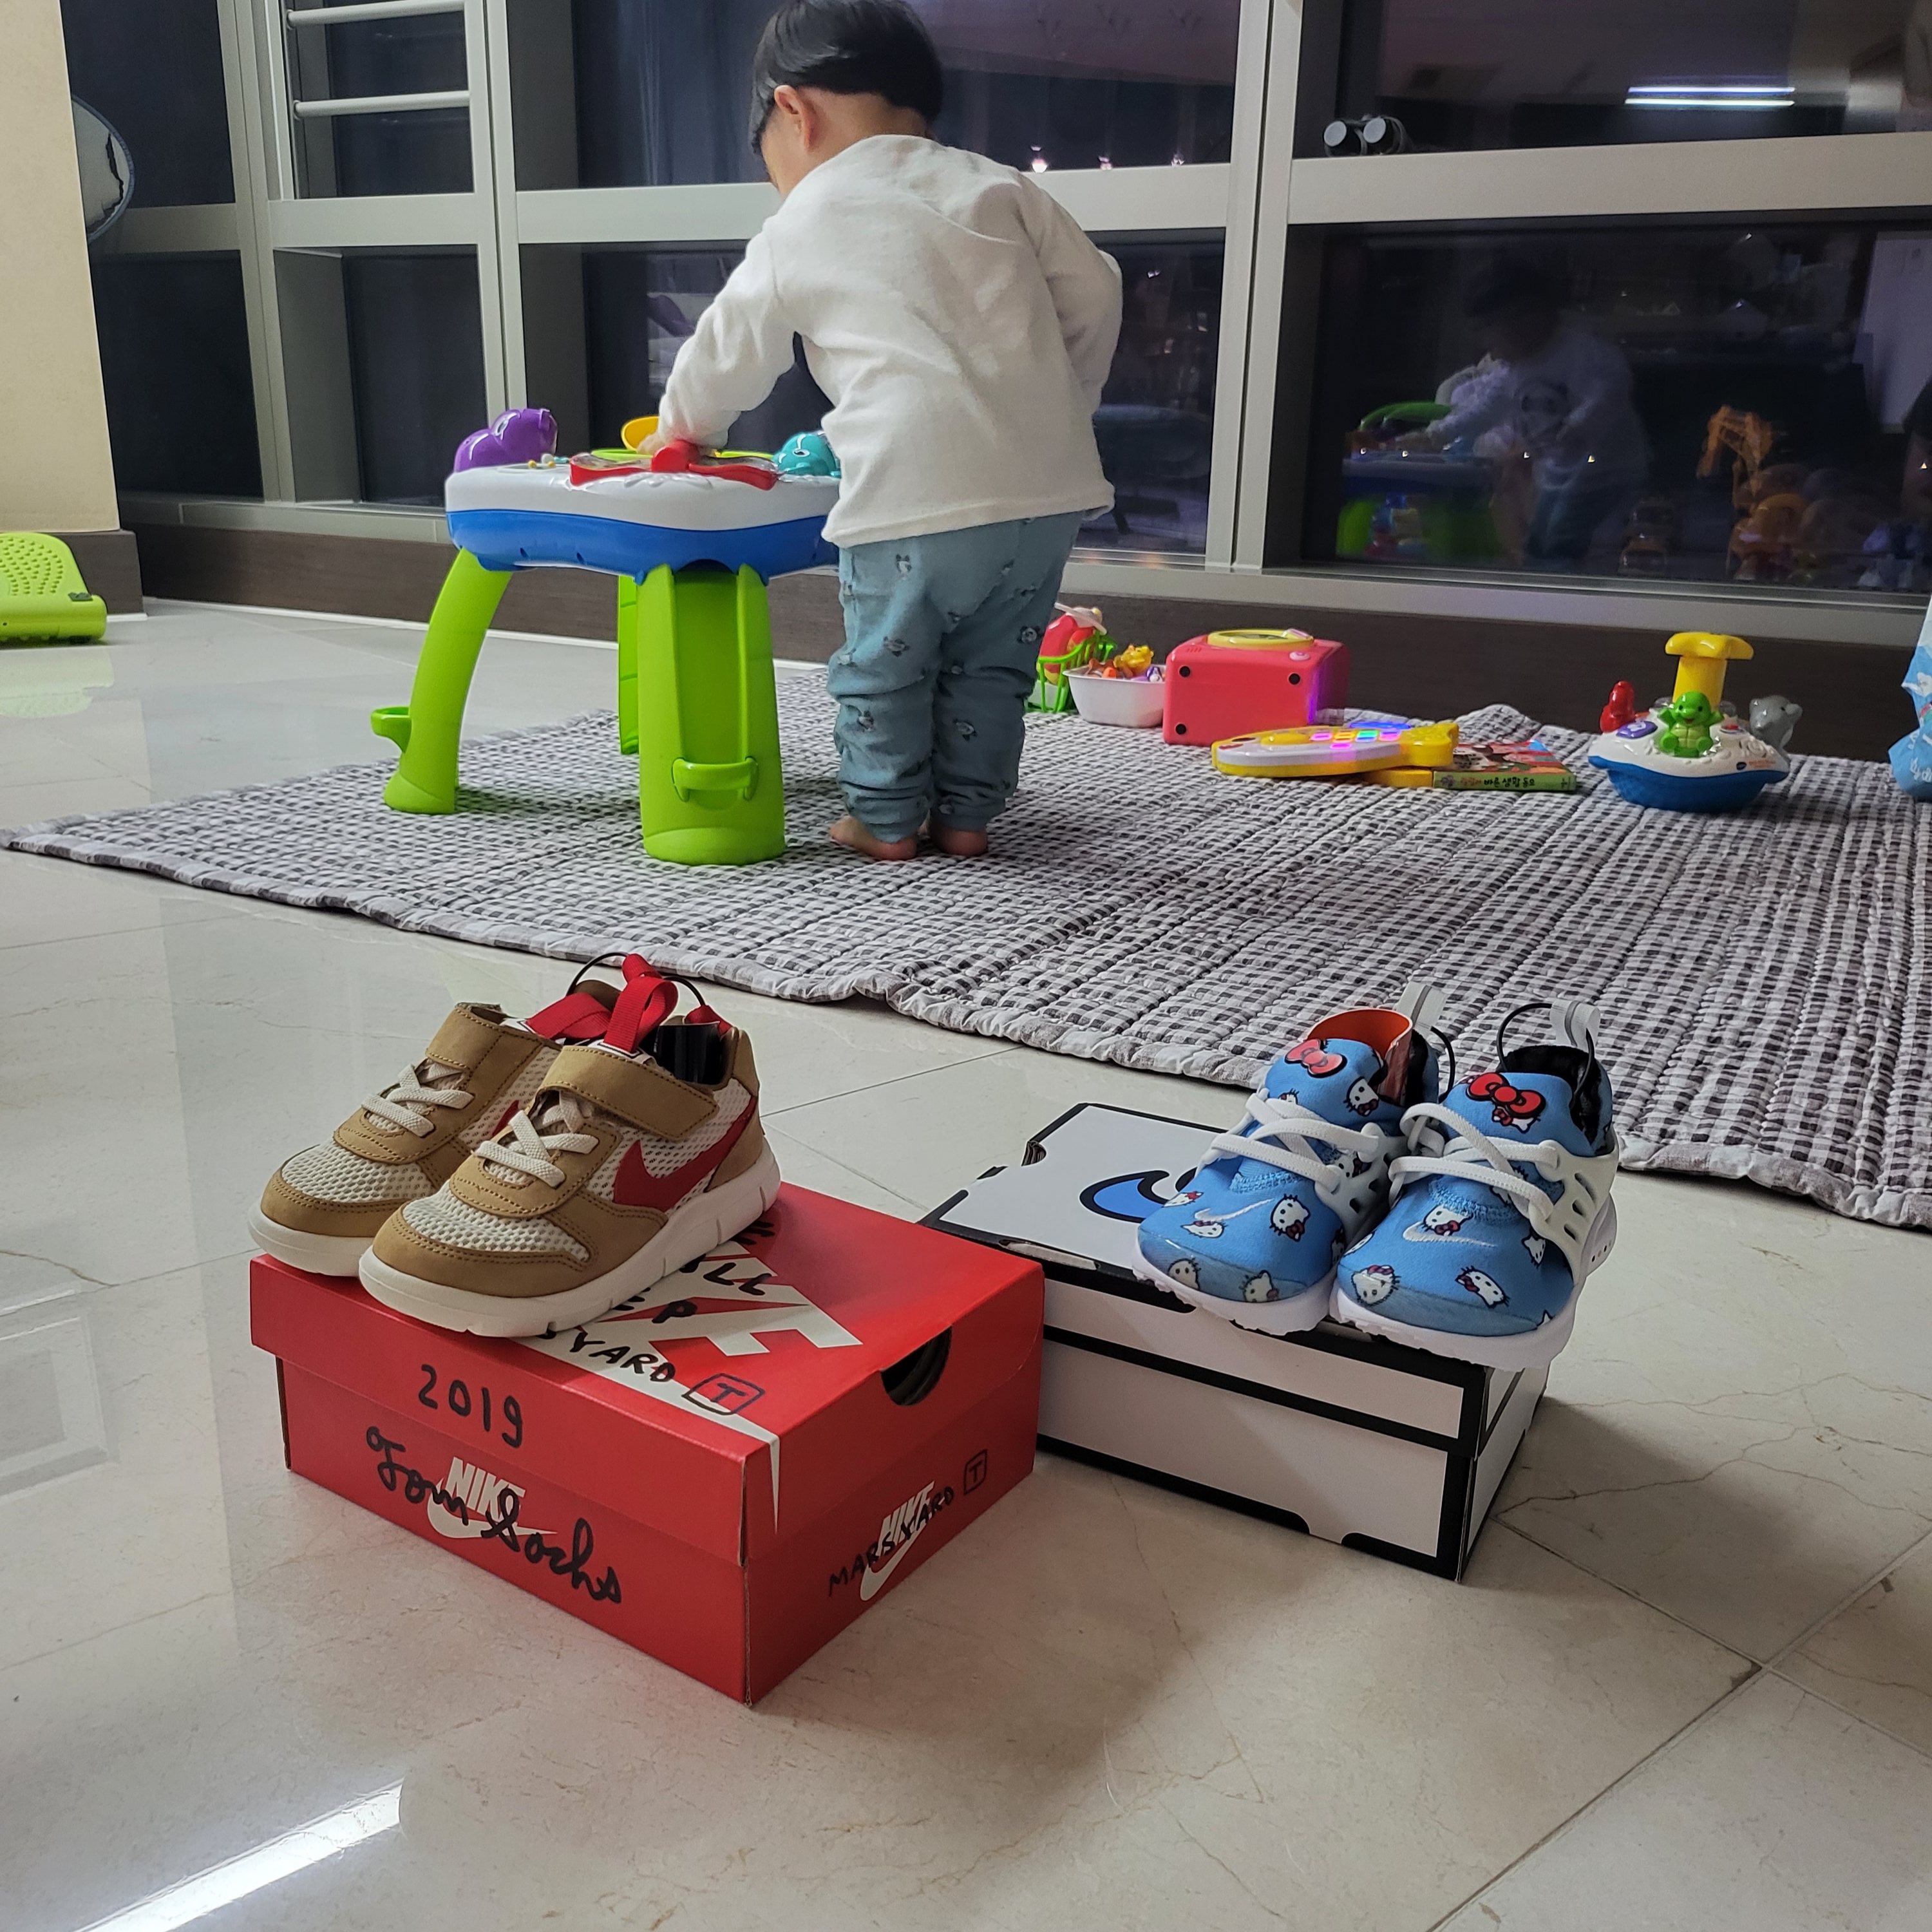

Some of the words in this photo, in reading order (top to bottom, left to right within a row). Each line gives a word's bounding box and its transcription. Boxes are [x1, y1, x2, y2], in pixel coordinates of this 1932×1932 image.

[569, 1327, 676, 1383] YARD
[418, 1363, 523, 1448] 2019
[829, 1531, 896, 1598] MARS
[900, 1486, 954, 1540] YARD
